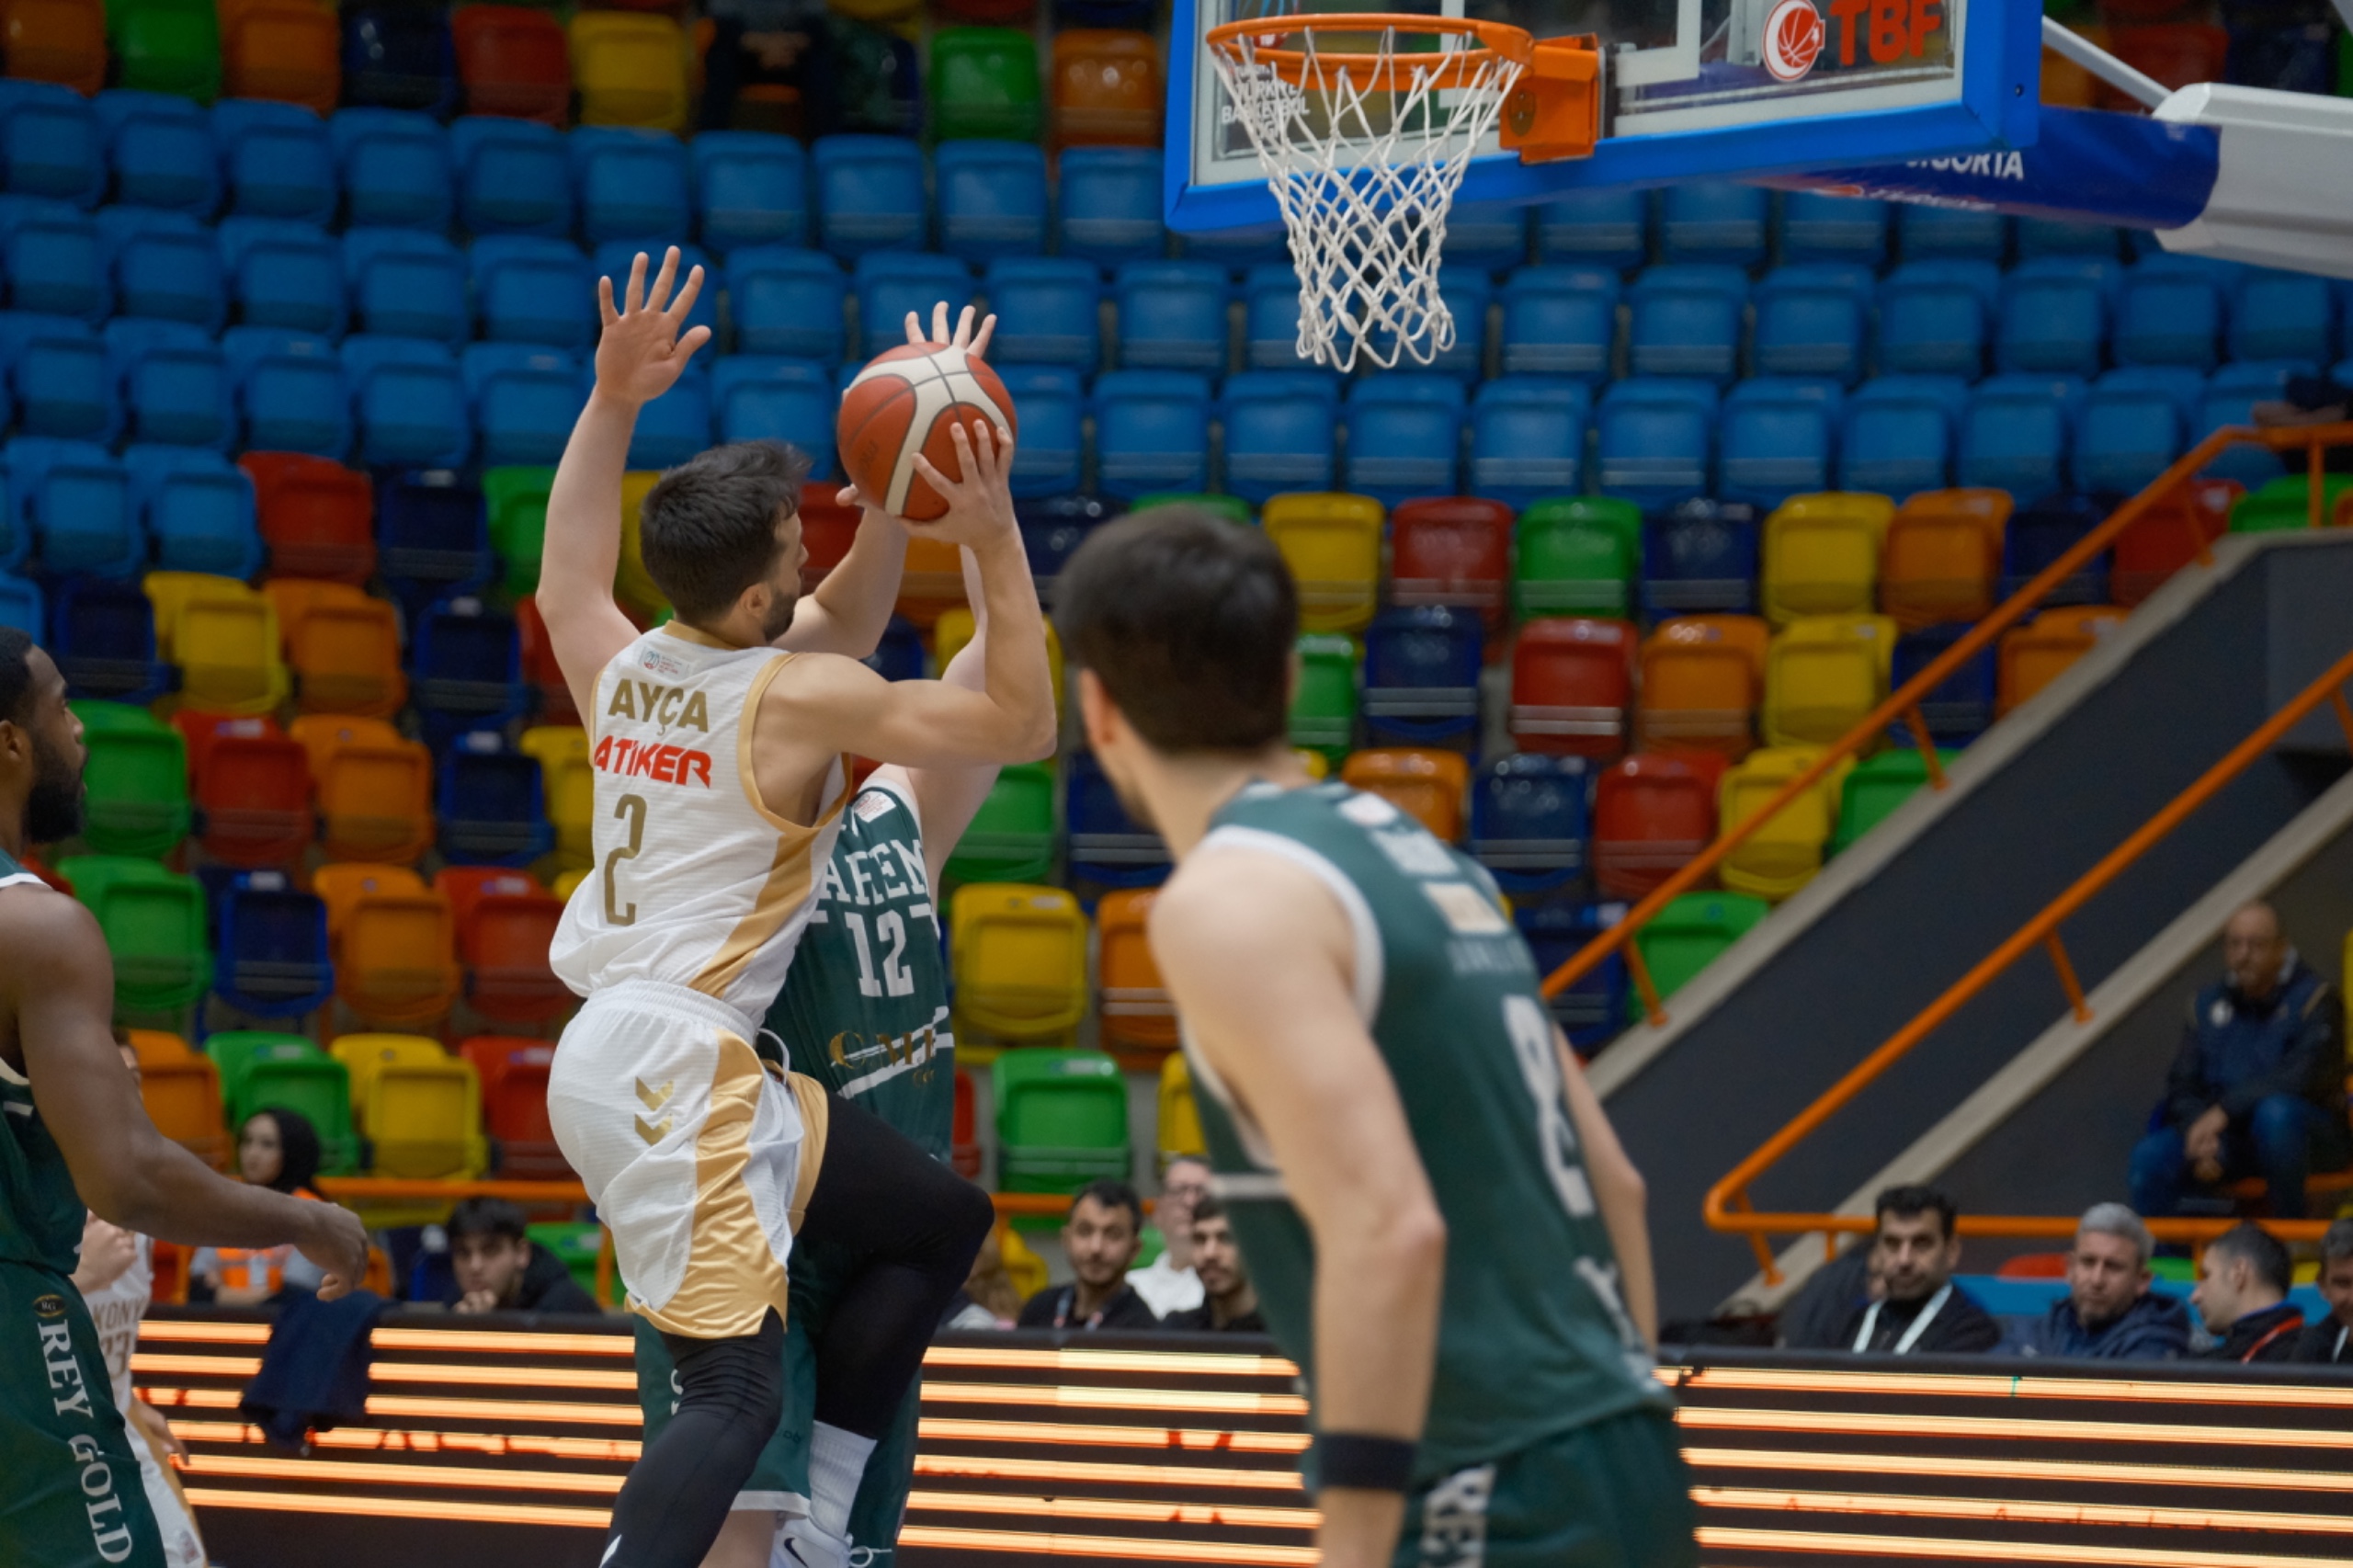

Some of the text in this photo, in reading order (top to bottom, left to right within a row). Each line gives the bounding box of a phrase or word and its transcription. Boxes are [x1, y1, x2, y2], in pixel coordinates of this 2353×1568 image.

[1829, 0, 1941, 65] TBF
[608, 678, 710, 735] AYÇA
[604, 793, 647, 926] 2
[844, 909, 915, 997] 12
[38, 1319, 132, 1562] REY GOLD
